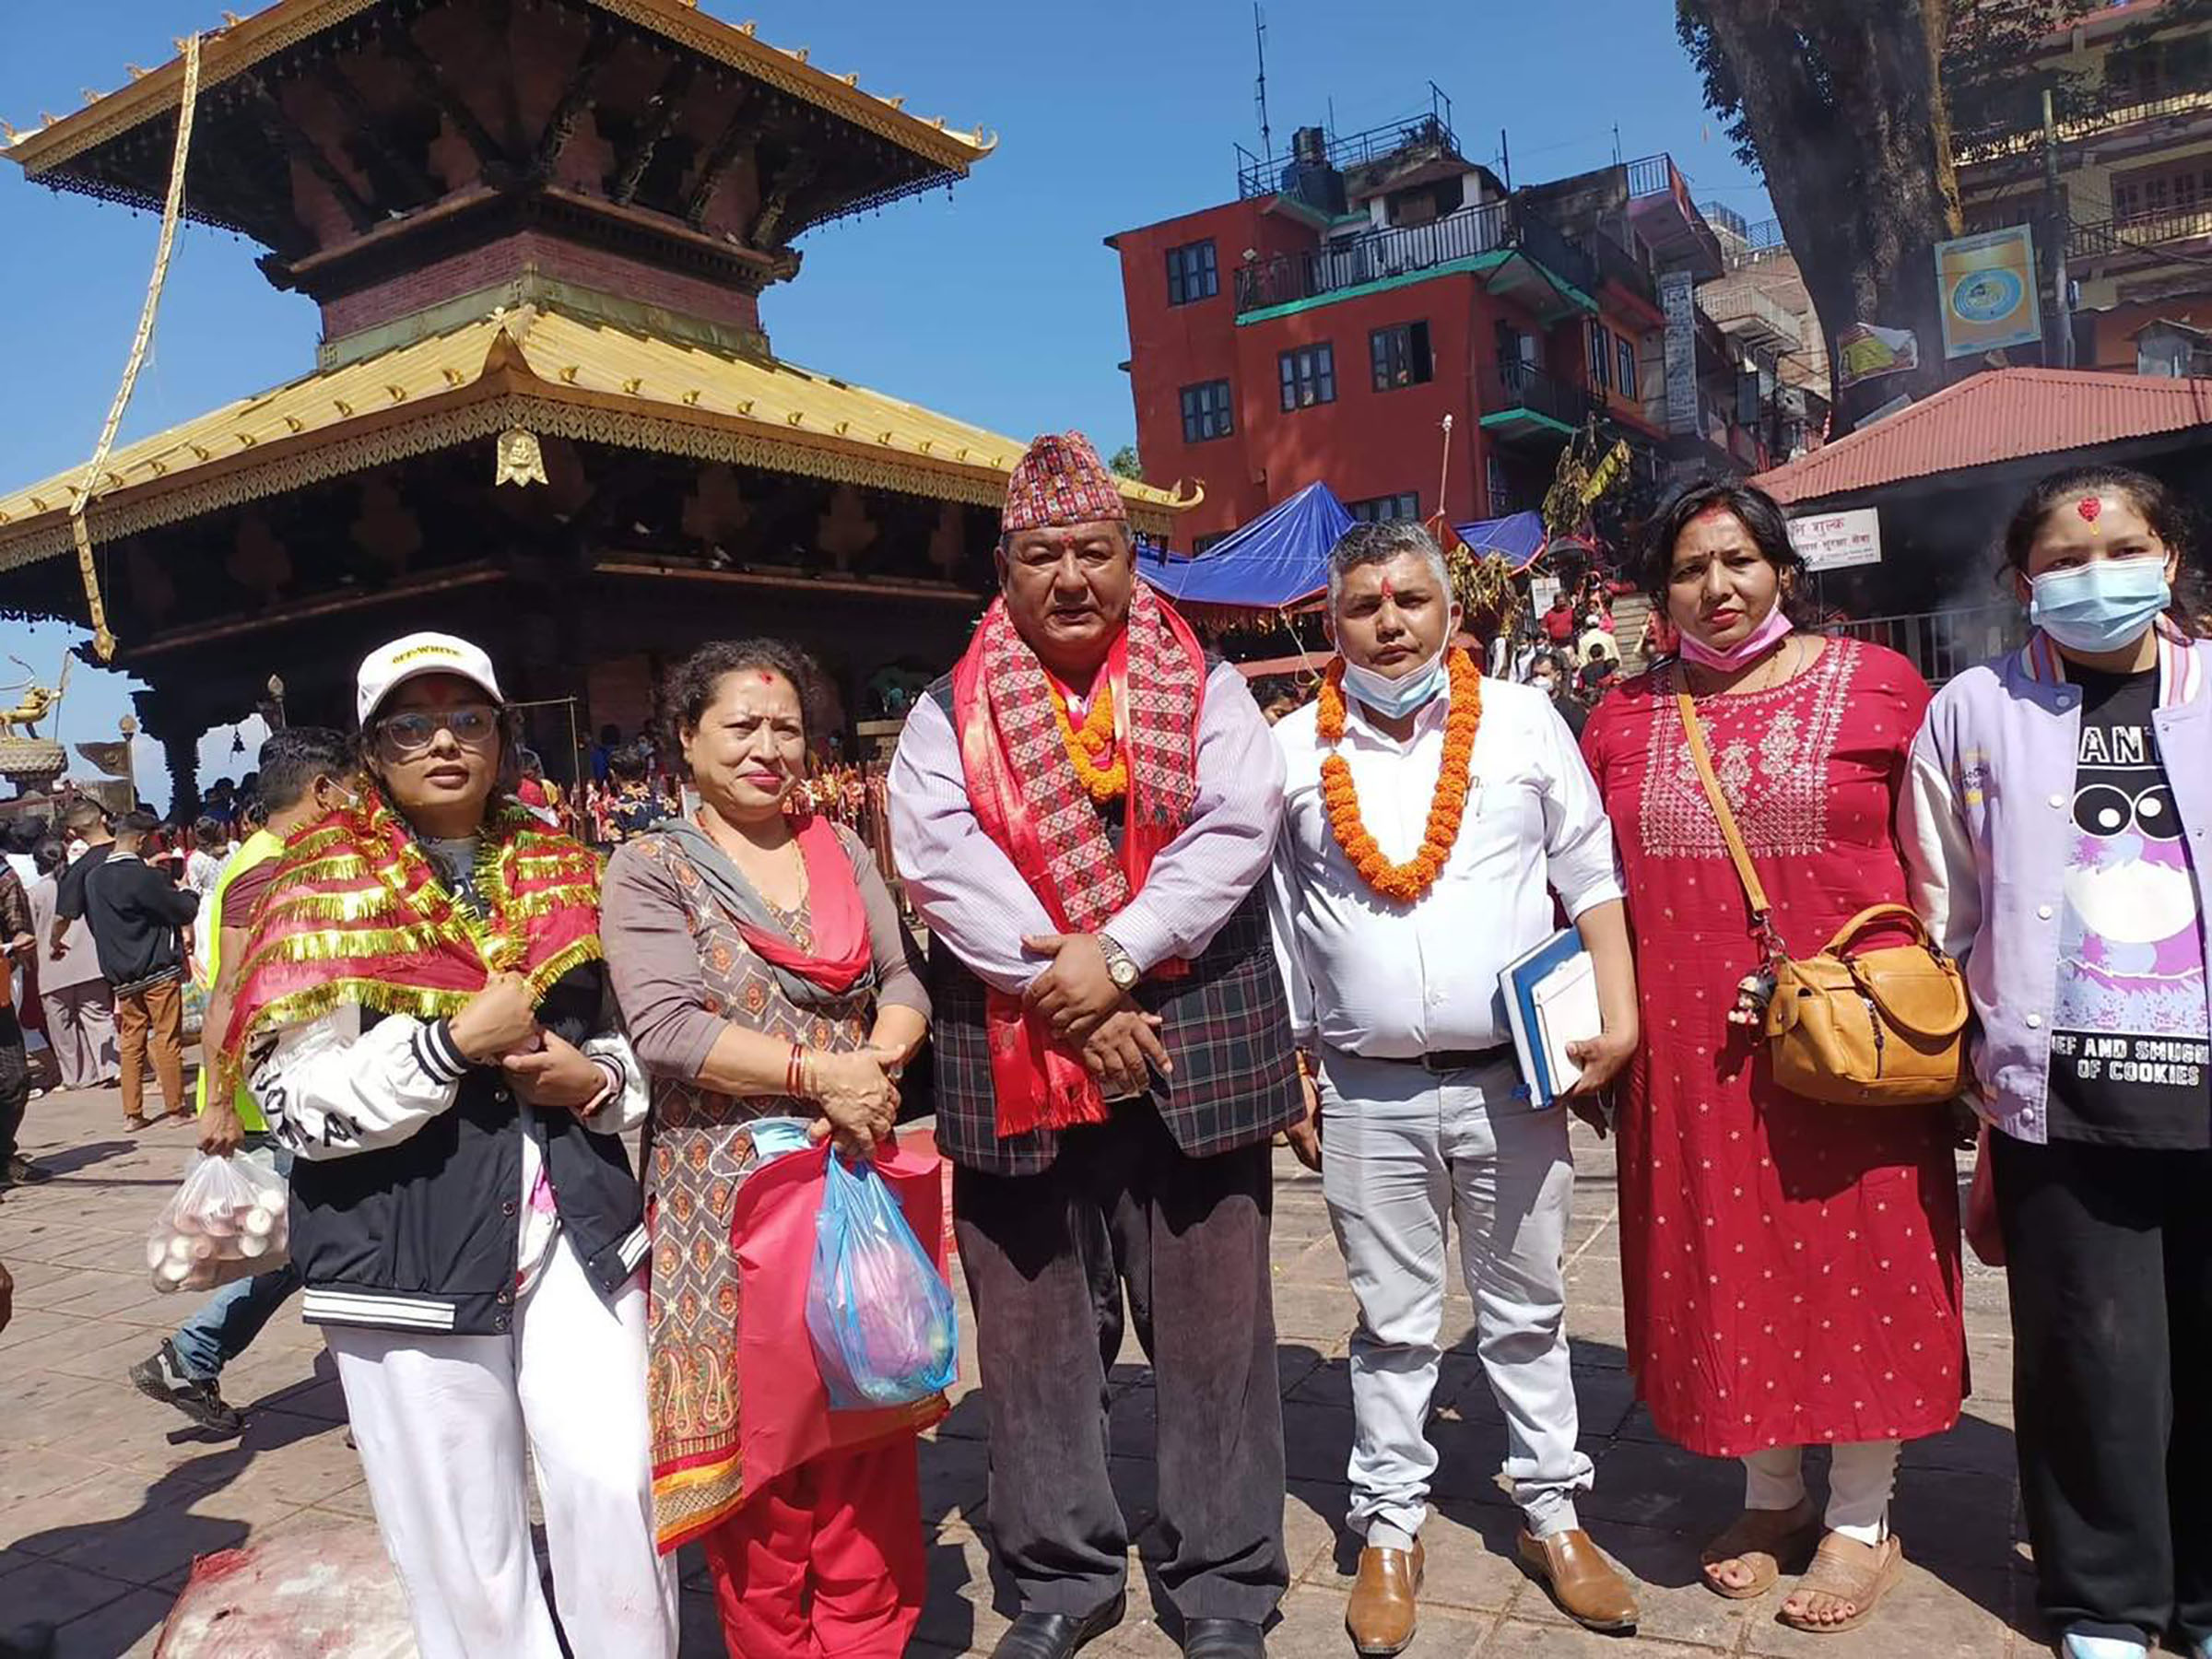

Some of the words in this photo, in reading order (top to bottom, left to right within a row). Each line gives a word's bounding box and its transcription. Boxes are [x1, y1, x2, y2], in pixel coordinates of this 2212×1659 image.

[2084, 1038, 2127, 1059] AND
[2077, 1059, 2101, 1079] OF
[2109, 1061, 2200, 1086] COOKIES
